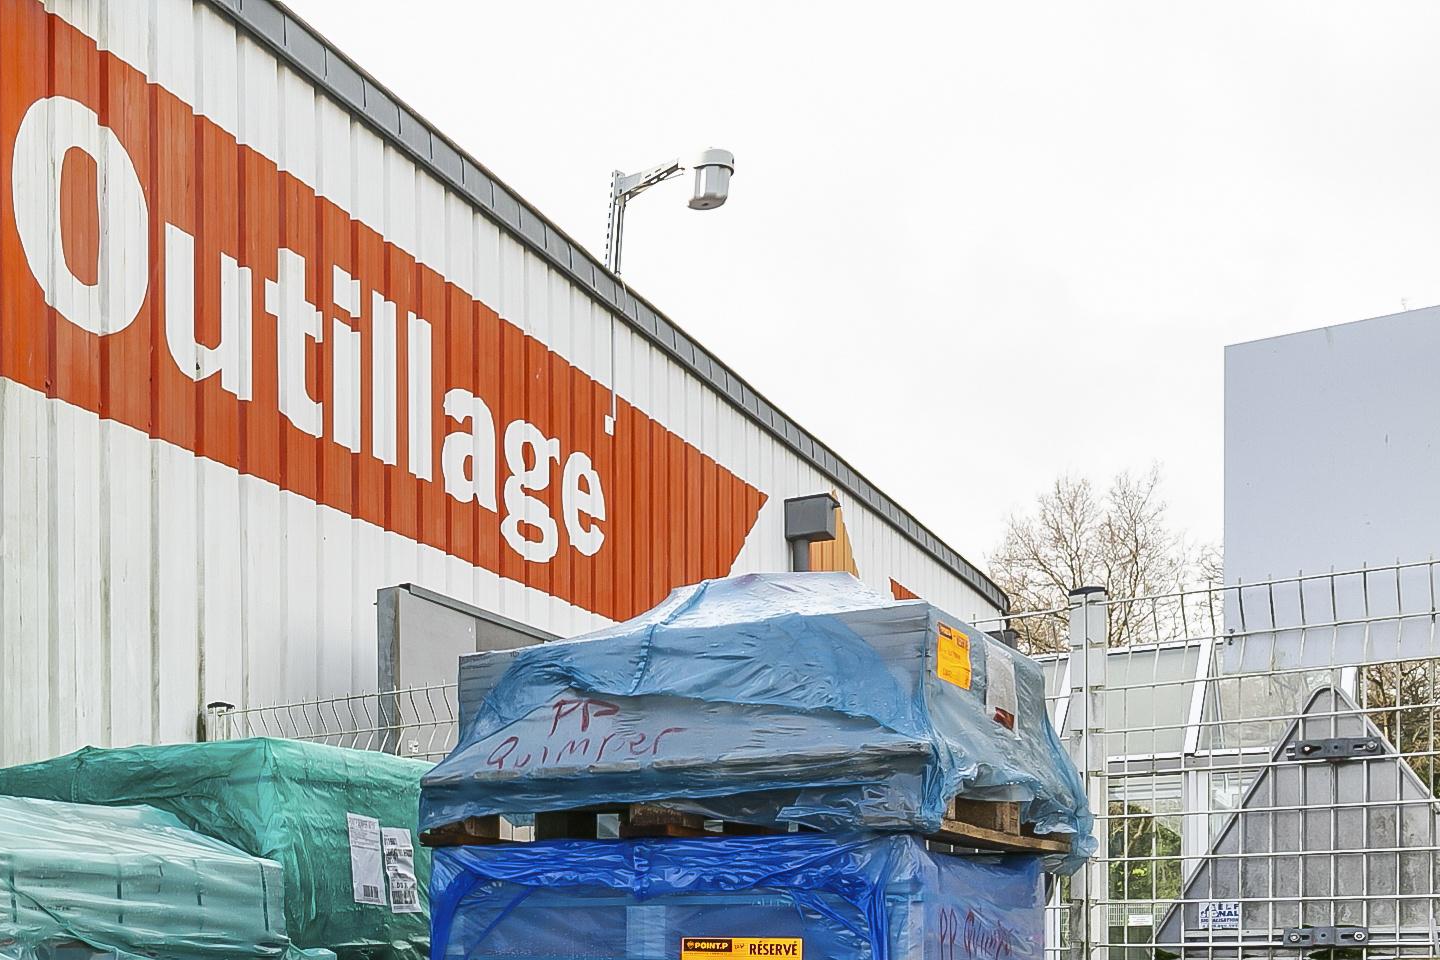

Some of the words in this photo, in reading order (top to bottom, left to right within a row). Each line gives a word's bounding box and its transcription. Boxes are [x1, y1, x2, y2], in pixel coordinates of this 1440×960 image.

[11, 95, 606, 563] Outillage
[694, 941, 729, 950] POINT.P
[749, 940, 798, 956] RÉSERVÉ
